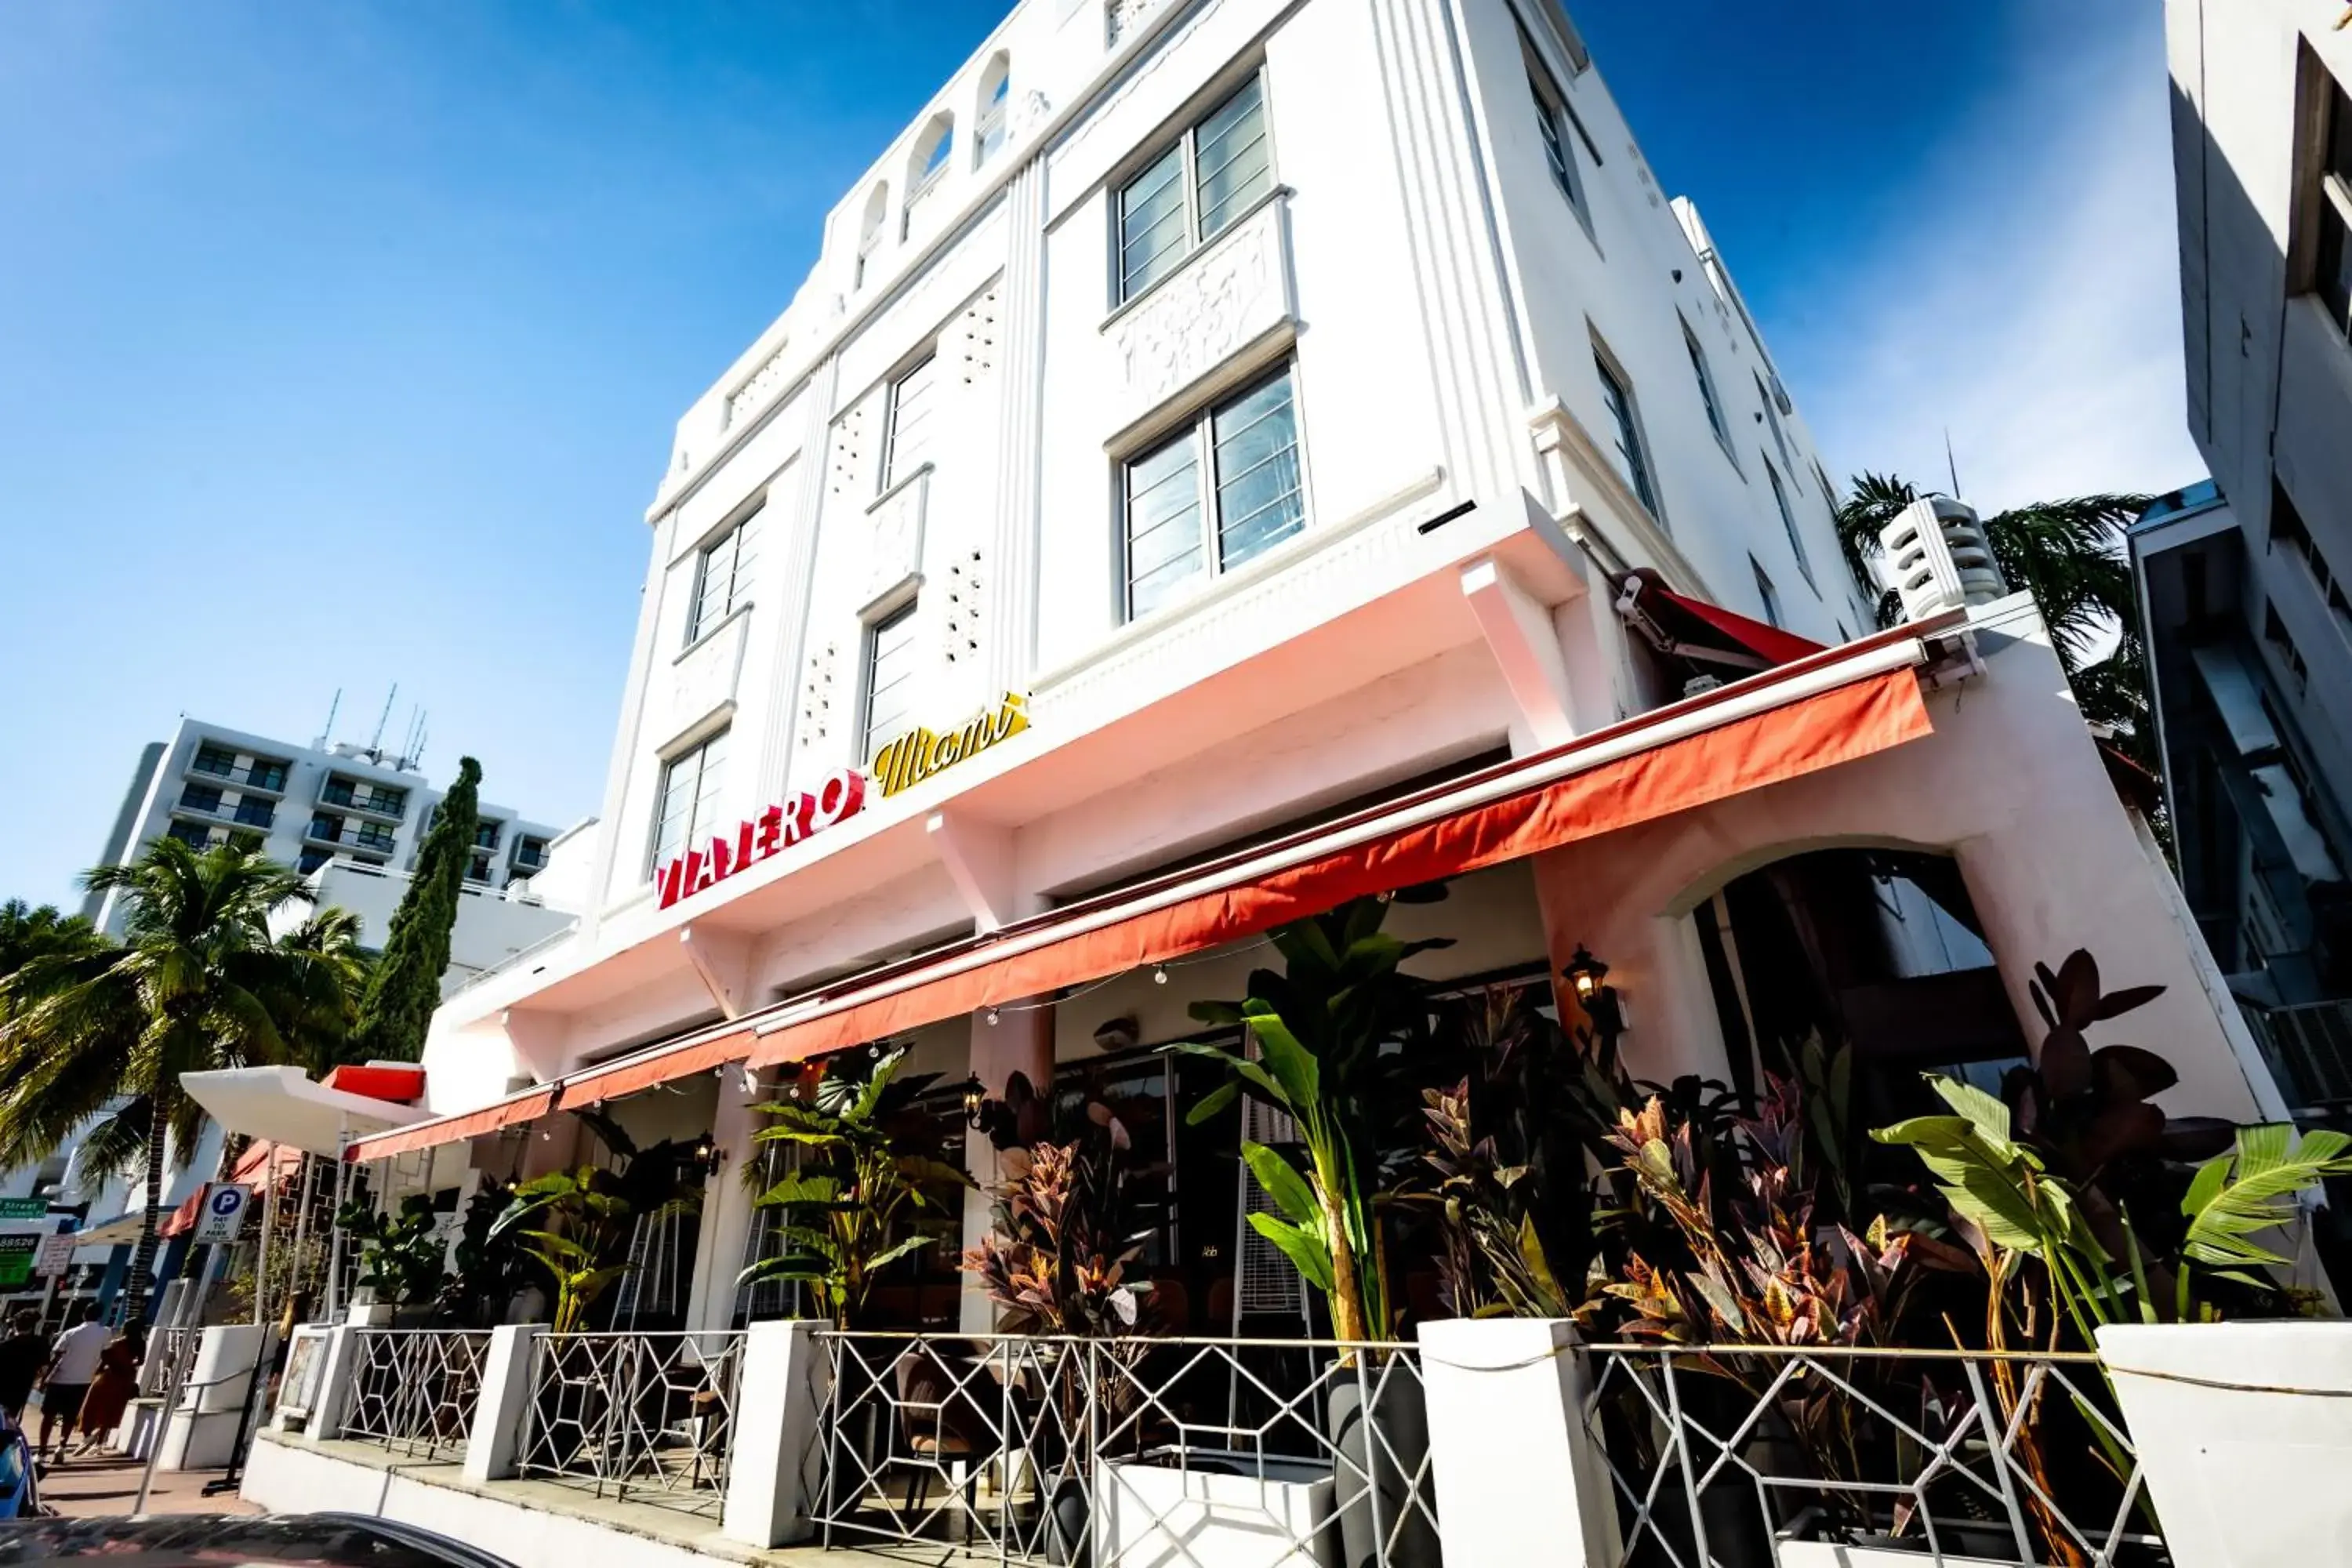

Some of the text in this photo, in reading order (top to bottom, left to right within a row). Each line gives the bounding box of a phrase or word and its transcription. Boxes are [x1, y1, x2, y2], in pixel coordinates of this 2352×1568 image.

[654, 691, 1032, 910] VIAJERO Miami
[4, 1202, 38, 1210] Street
[219, 1193, 235, 1210] P
